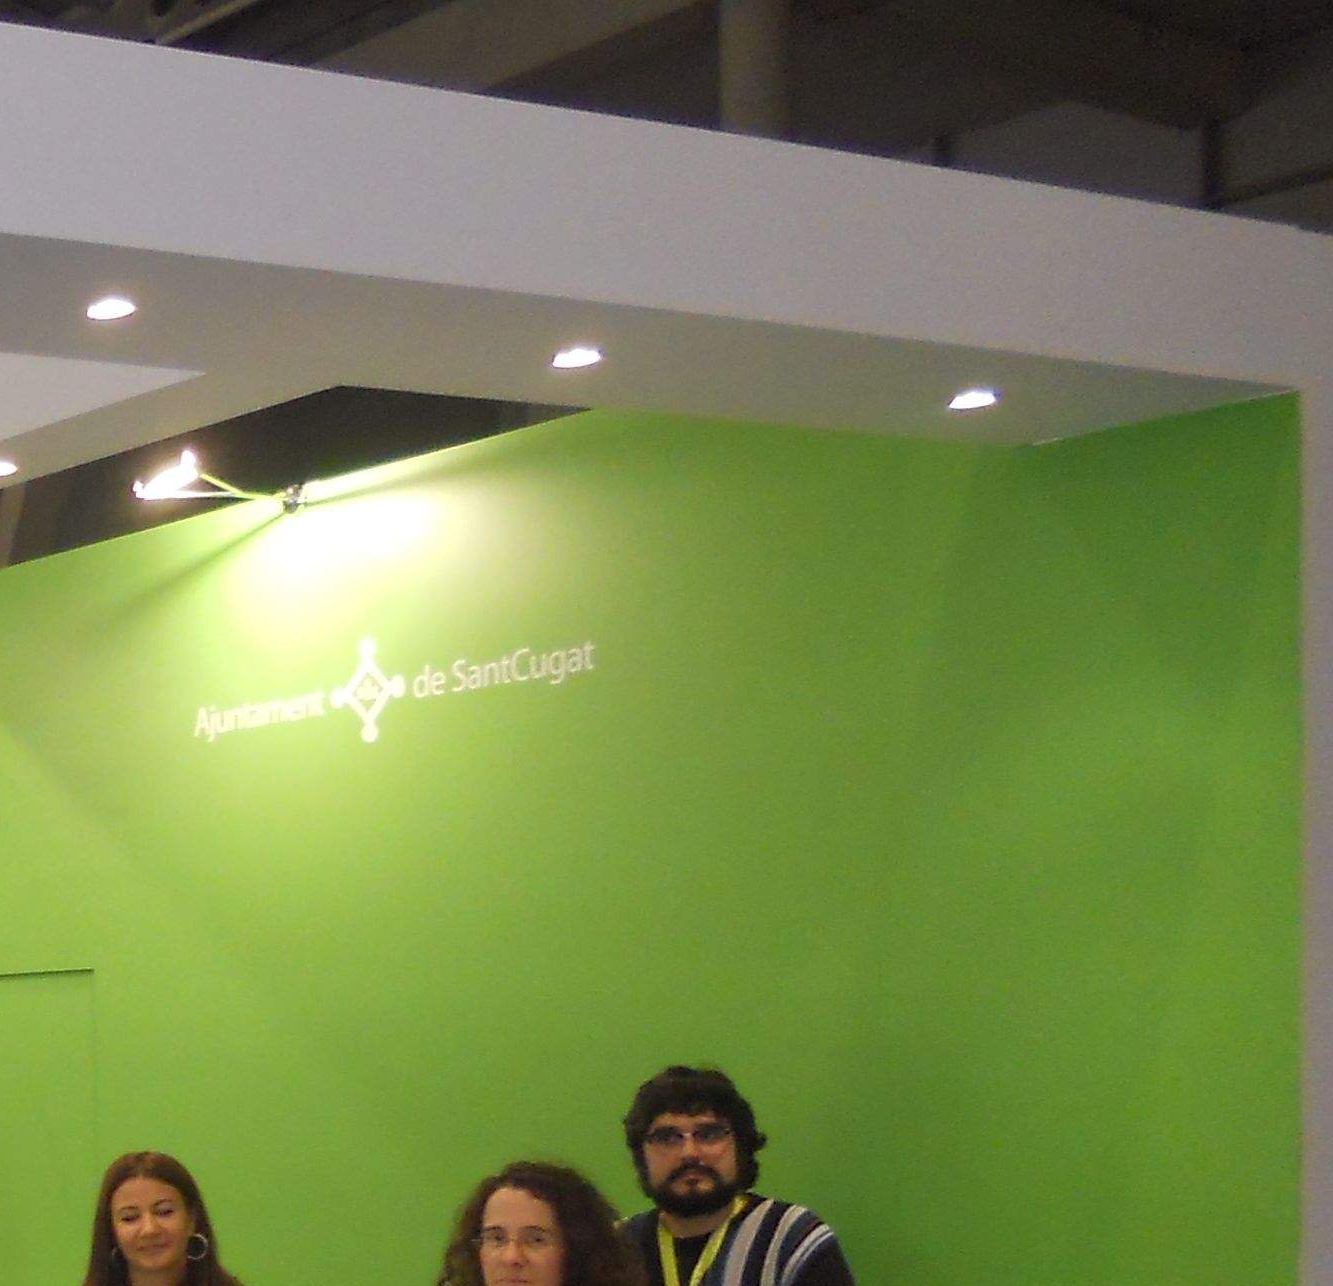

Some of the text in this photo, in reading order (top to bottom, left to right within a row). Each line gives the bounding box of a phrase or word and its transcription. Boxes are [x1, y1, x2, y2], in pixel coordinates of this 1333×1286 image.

[193, 641, 596, 742] Ajuntament de SantCugat
